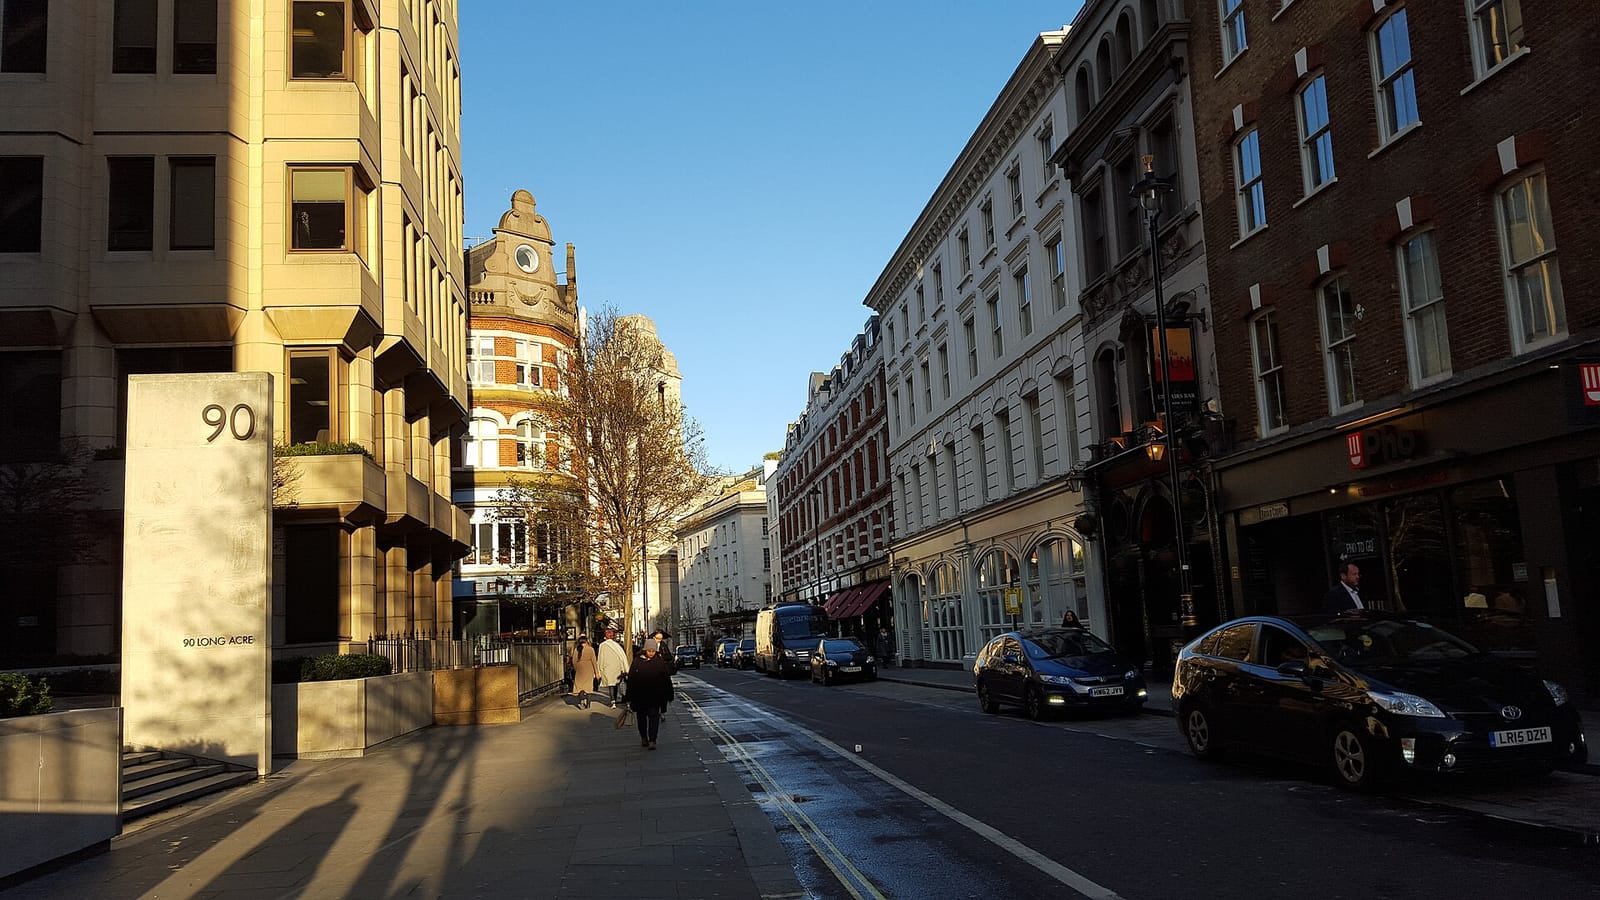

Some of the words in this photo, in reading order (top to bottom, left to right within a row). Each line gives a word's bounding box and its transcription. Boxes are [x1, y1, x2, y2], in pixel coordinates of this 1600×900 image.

[201, 403, 256, 442] 90
[1363, 425, 1416, 465] Pho
[1345, 542, 1357, 554] PHO
[1356, 541, 1365, 553] TO
[183, 638, 195, 647] 90
[197, 636, 226, 647] LONG
[228, 635, 253, 645] ACRE
[1499, 731, 1524, 744] LR15
[1527, 729, 1548, 742] DZH
